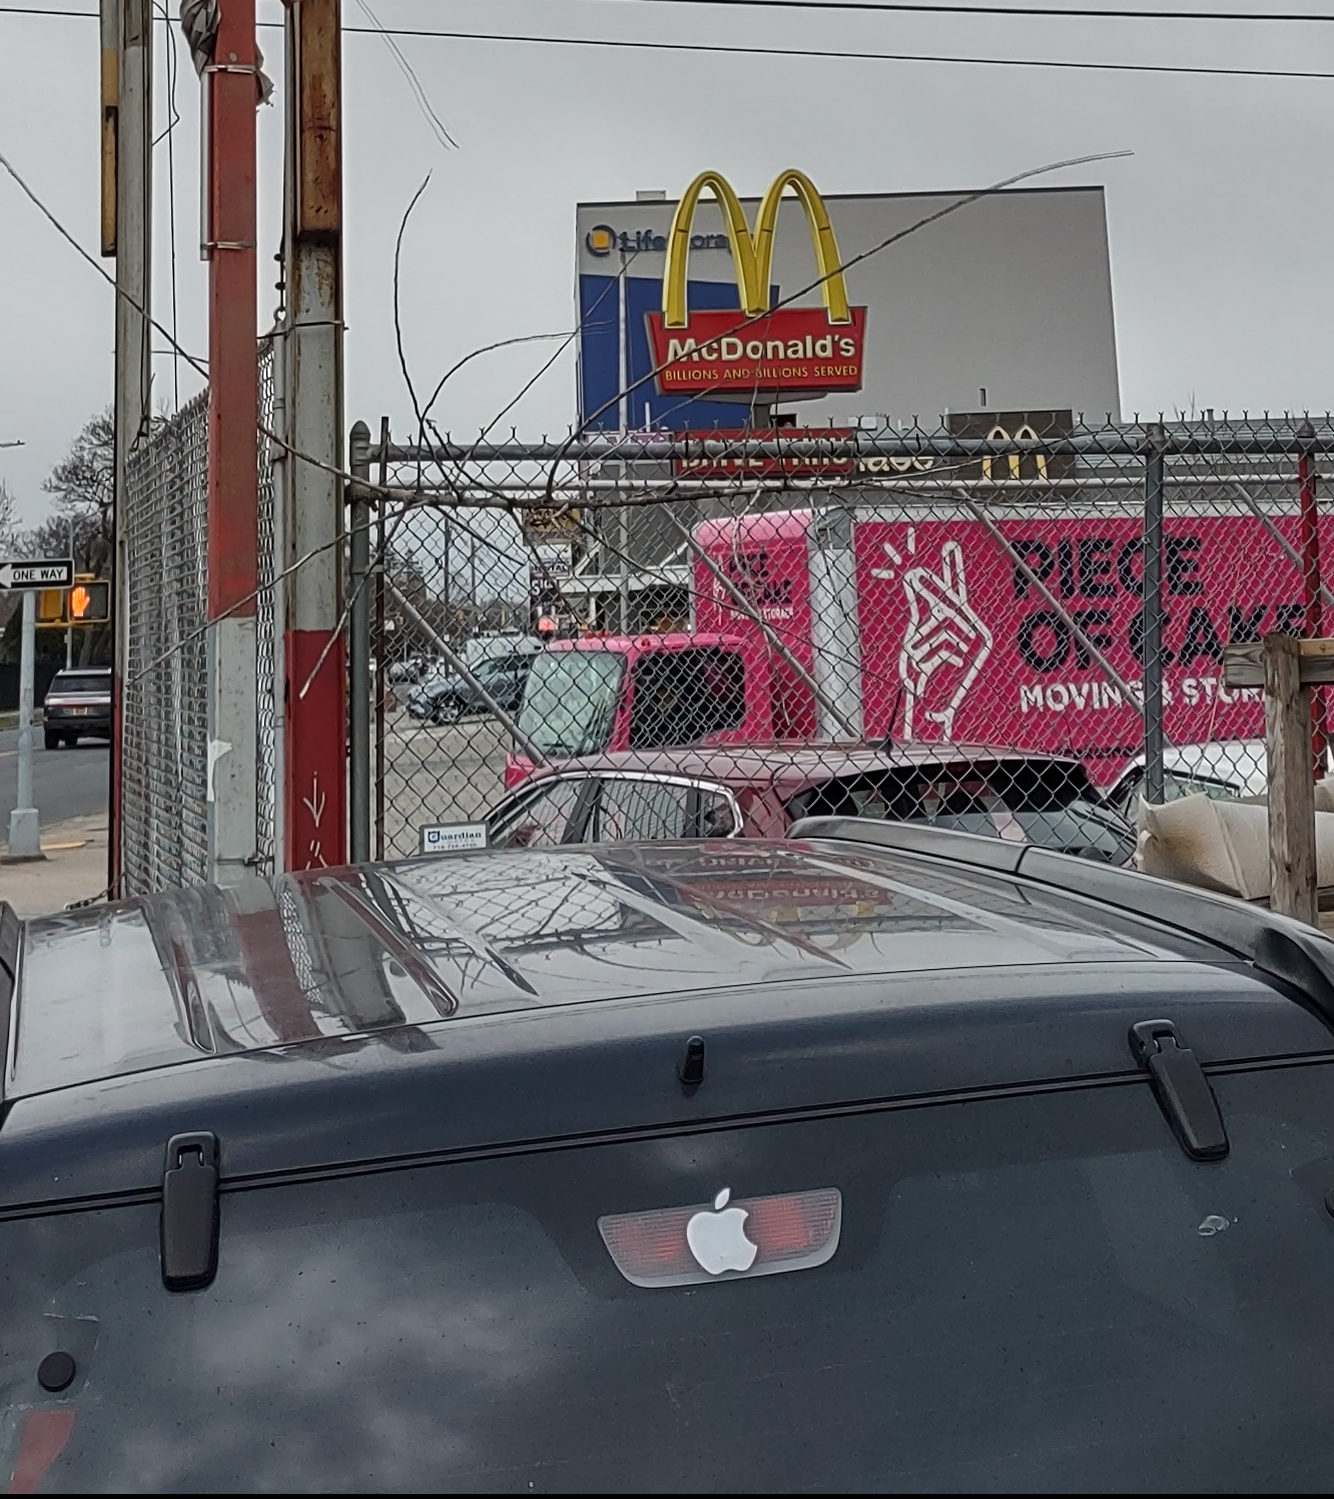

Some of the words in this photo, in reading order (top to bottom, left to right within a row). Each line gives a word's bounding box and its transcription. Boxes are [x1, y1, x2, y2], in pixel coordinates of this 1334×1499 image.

[621, 230, 666, 251] Life
[667, 334, 856, 363] McDonald's
[665, 368, 719, 381] BILLIONS
[723, 367, 751, 380] AND
[755, 367, 808, 379] BILLIONS
[814, 365, 858, 377] SERVED
[13, 568, 37, 581] ONE
[40, 568, 64, 580] WAY
[1012, 536, 1205, 600] PIECE
[1017, 609, 1113, 673] OF
